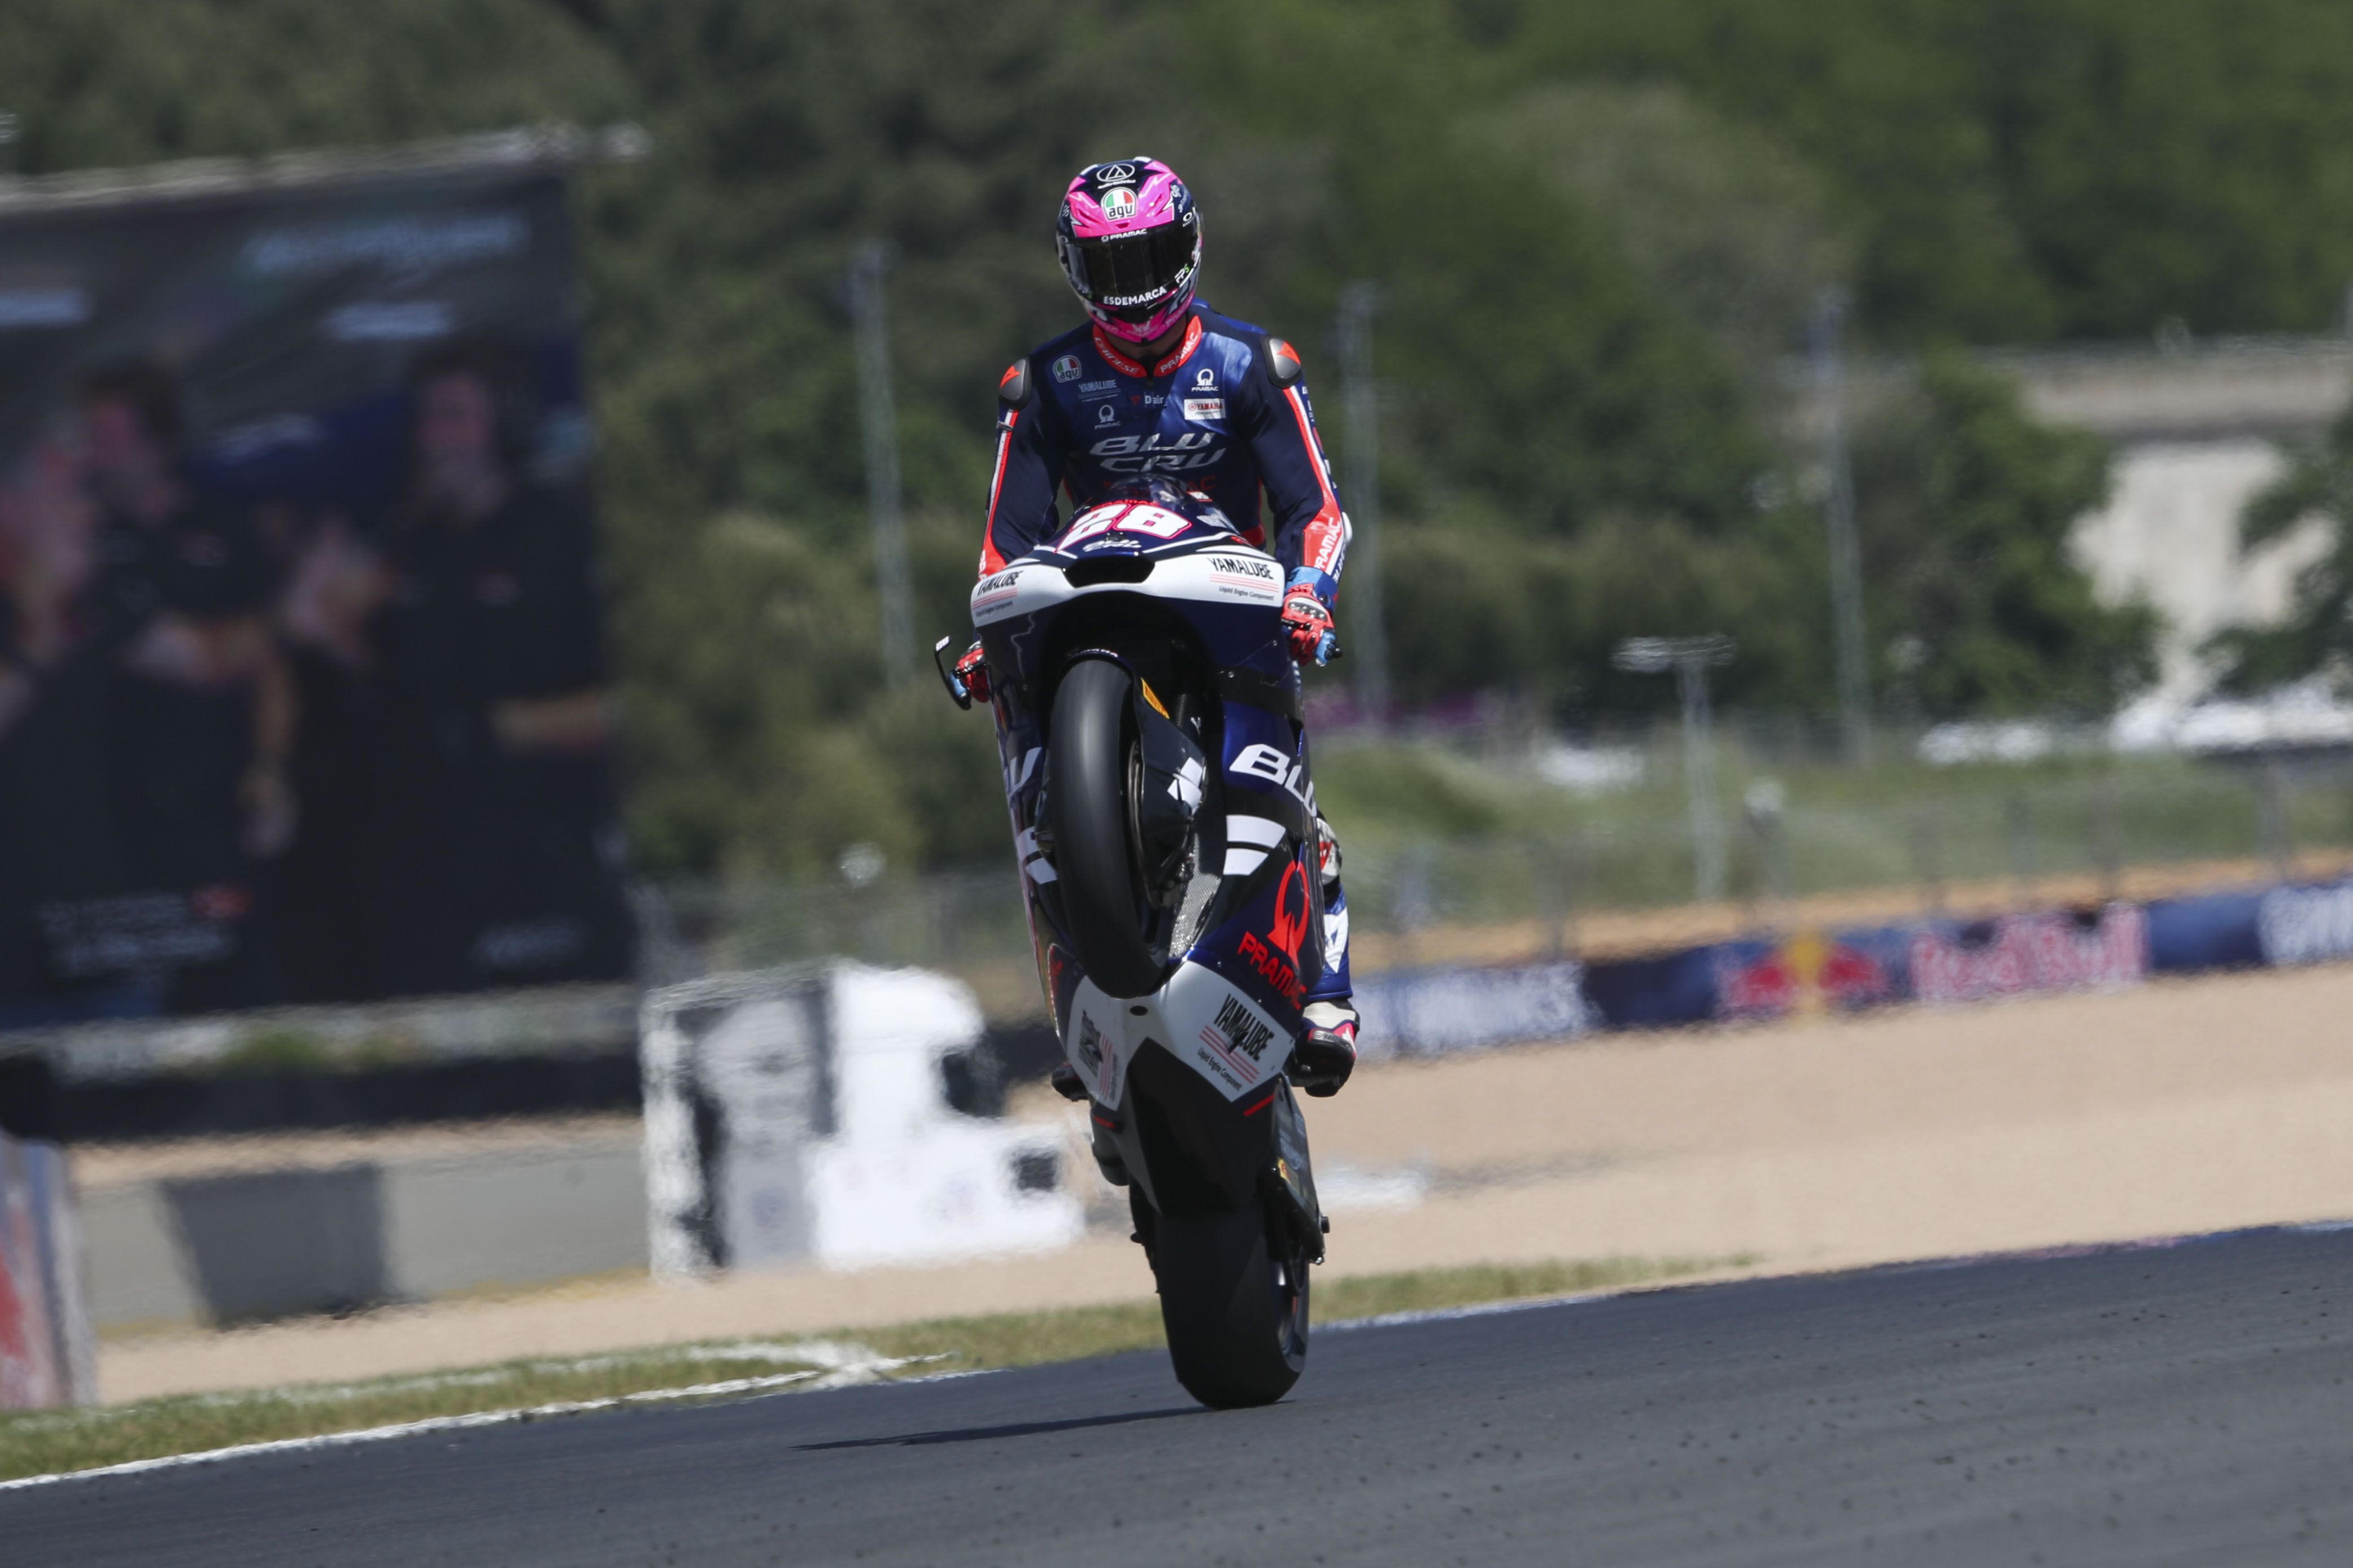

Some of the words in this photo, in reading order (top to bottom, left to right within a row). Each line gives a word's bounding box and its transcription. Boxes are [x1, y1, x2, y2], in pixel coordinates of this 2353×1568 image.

[1109, 204, 1133, 217] agv
[1110, 228, 1147, 240] PRAMAC
[1103, 286, 1167, 305] ESDEMARCA
[1161, 332, 1199, 373] PRAMAC
[1060, 368, 1079, 380] agv
[1078, 379, 1117, 392] YAMALUBE
[1196, 401, 1223, 410] YAMAHA
[1089, 433, 1215, 456] BLU
[1100, 448, 1227, 472] CRU
[1314, 517, 1341, 569] RAMAC
[1206, 557, 1274, 580] YAMALUBE
